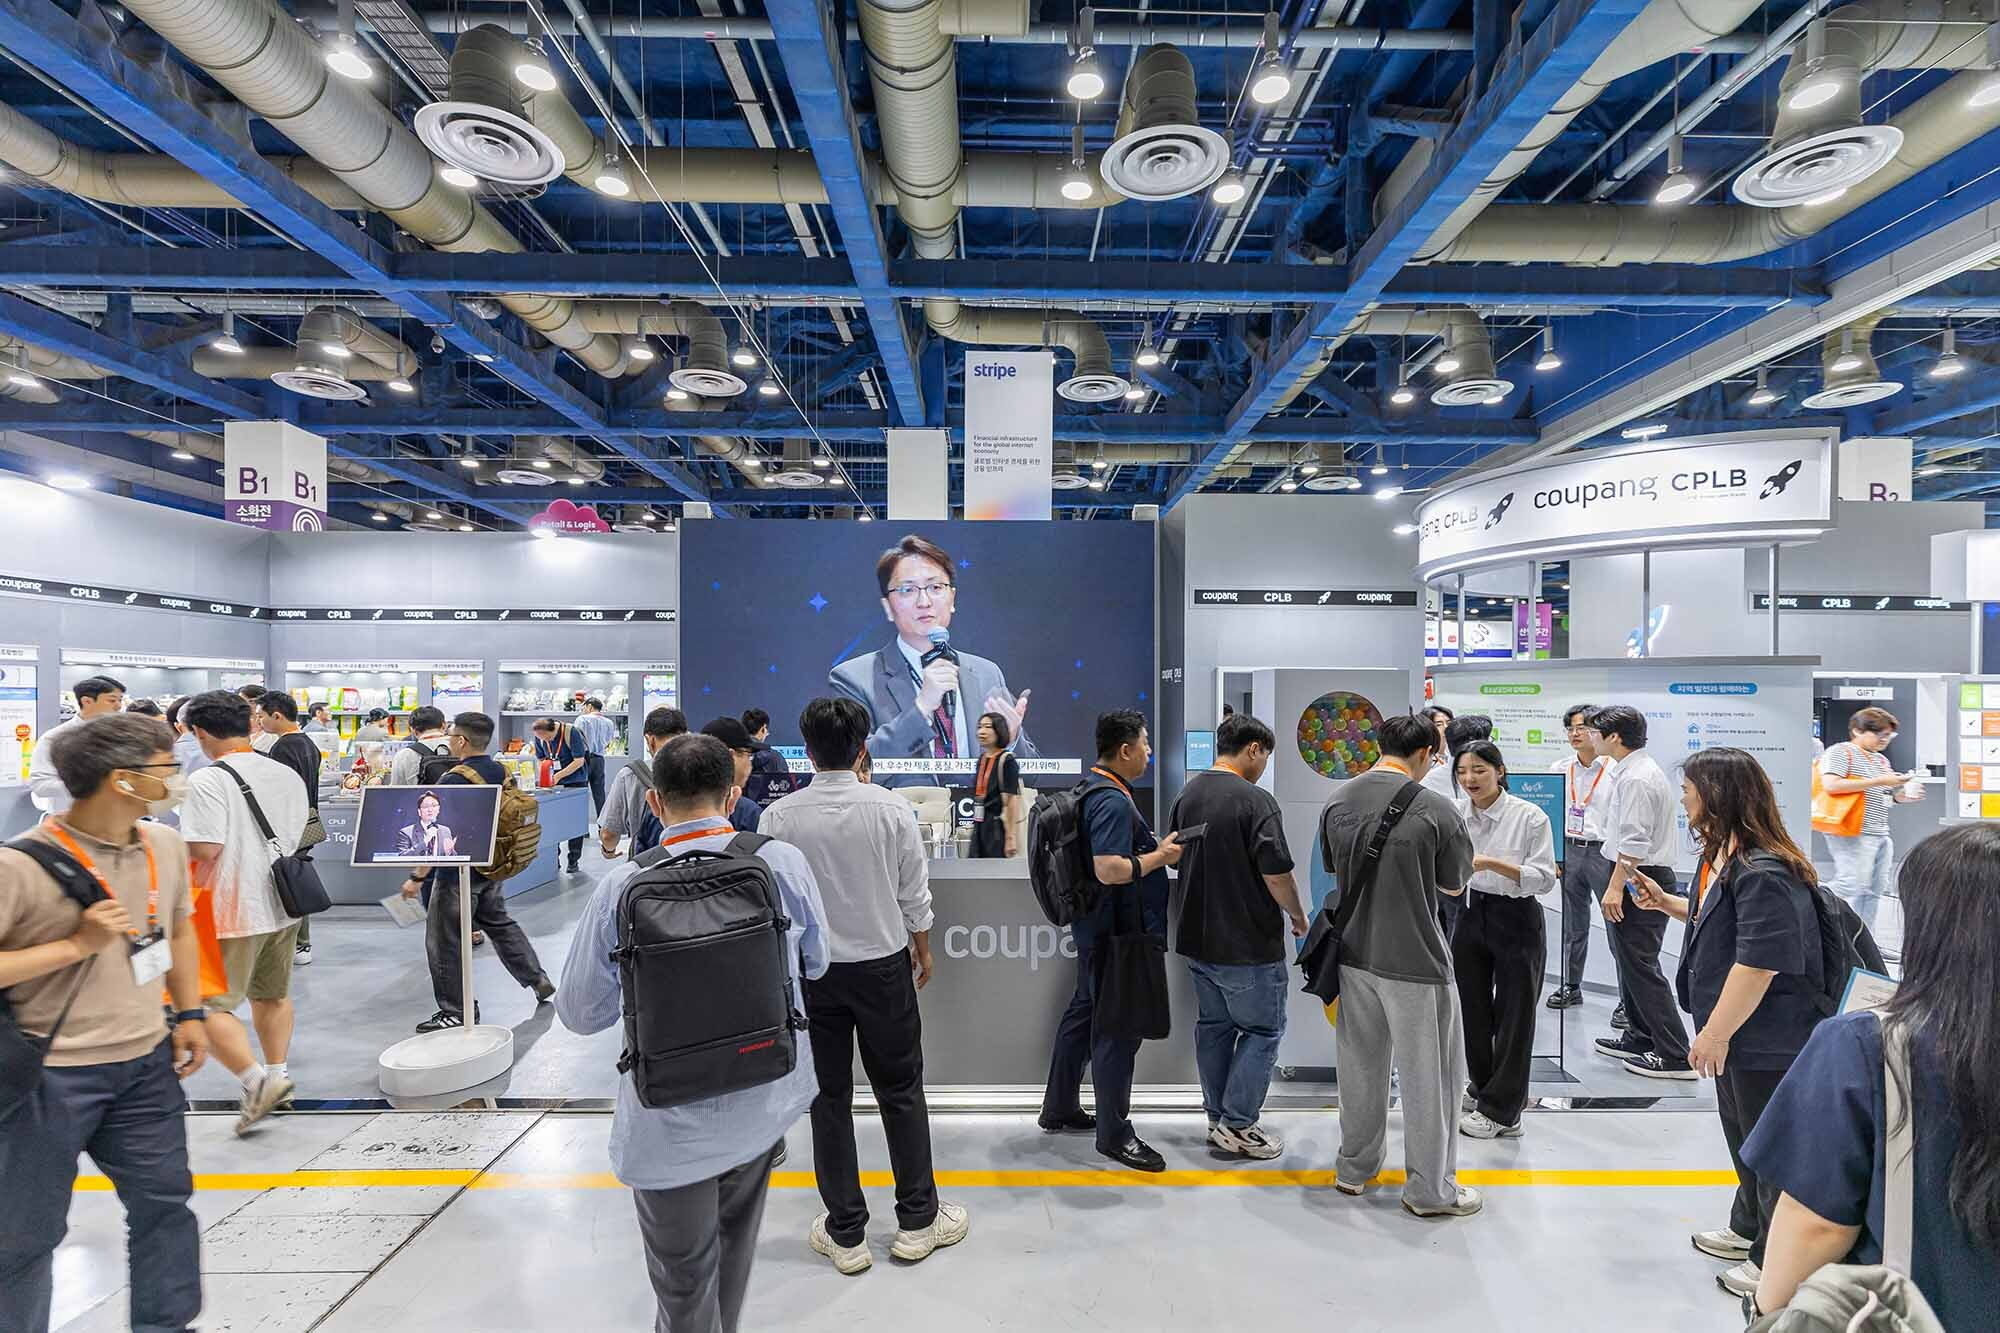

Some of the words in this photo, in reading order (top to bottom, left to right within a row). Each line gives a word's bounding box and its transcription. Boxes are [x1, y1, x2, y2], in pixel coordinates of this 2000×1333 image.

[974, 362, 1016, 380] stripe
[239, 467, 268, 494] B1
[295, 471, 317, 502] B1
[1534, 475, 1658, 509] coupang
[1671, 469, 1747, 491] CPLB
[235, 504, 272, 517] 소화전
[1444, 506, 1479, 528] CPLB
[70, 587, 100, 599] CPLB
[160, 598, 191, 609] coupang
[210, 604, 232, 614] CPLB
[1202, 592, 1239, 602] coupang
[1263, 593, 1292, 602] CPLB
[1356, 593, 1393, 603] coupang
[1822, 598, 1851, 608] CPLB
[277, 610, 307, 619] coupang
[327, 610, 352, 619] CPLB
[403, 611, 433, 619] coupang
[454, 611, 478, 620] CPLB
[530, 611, 560, 620] coupang
[580, 611, 603, 620] CPLB
[1856, 688, 1876, 697] GIFT
